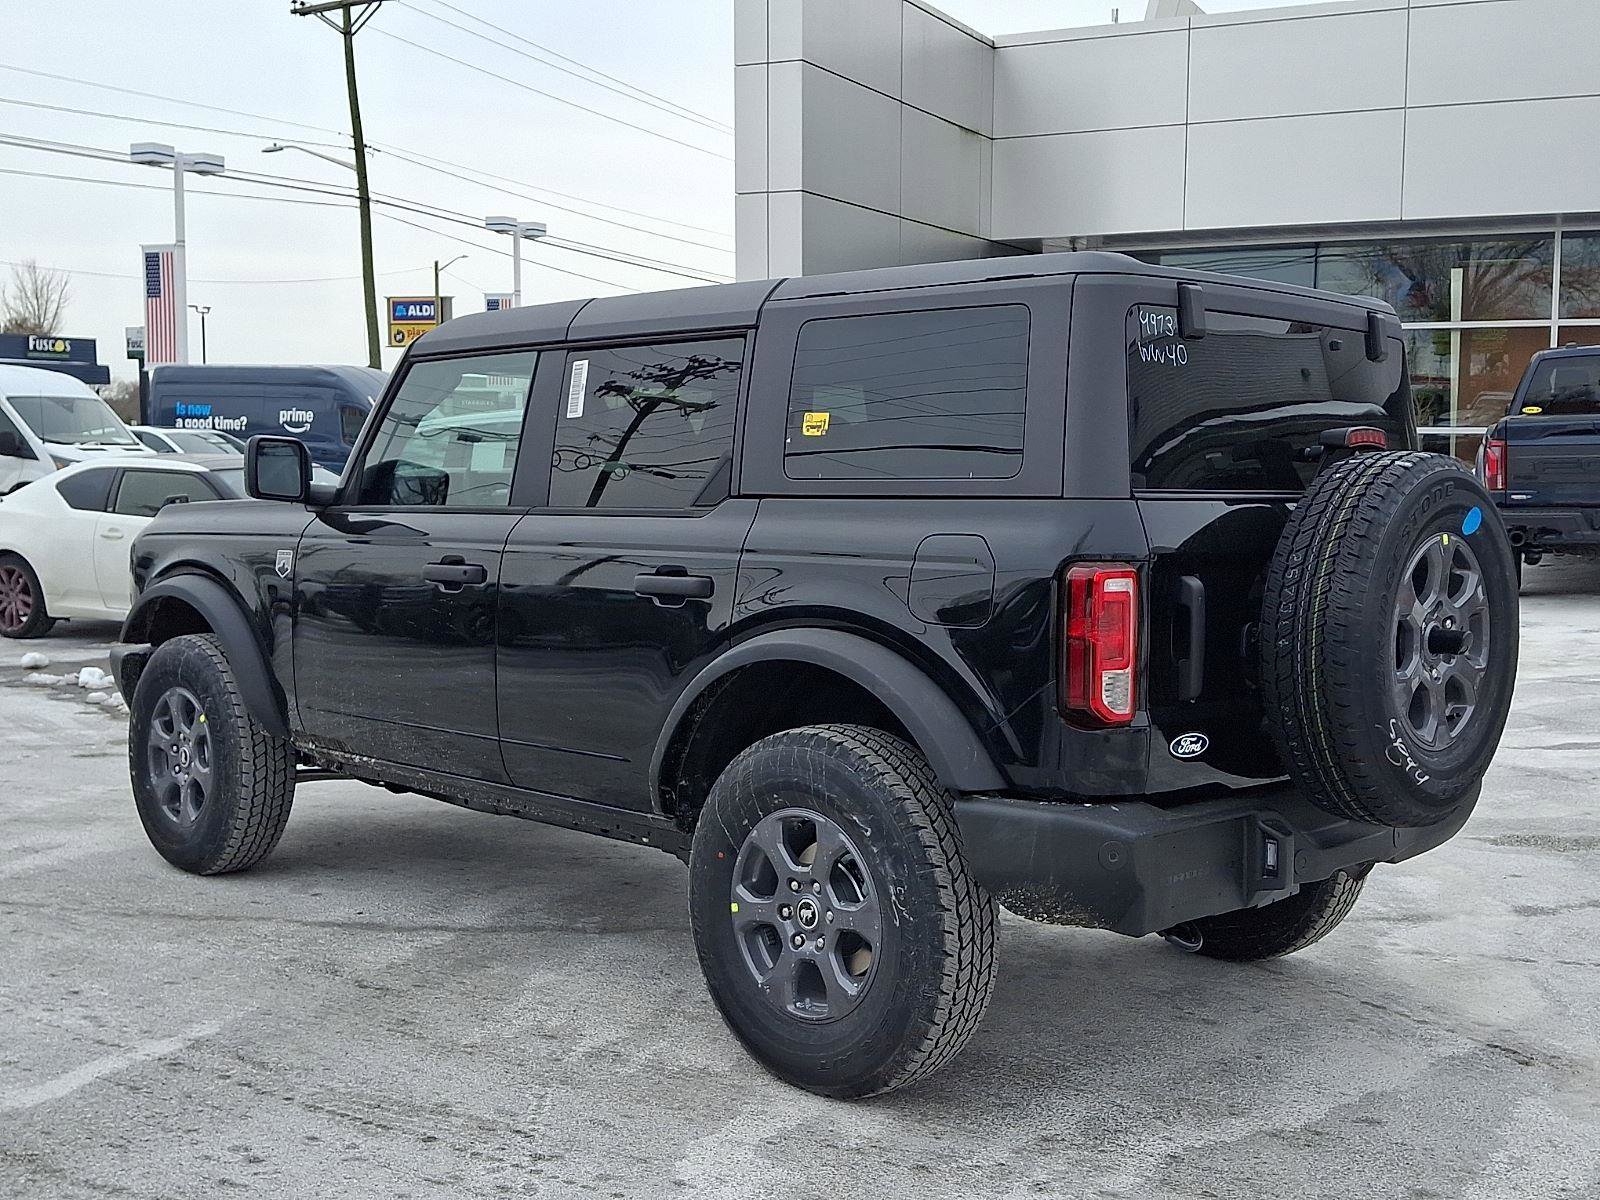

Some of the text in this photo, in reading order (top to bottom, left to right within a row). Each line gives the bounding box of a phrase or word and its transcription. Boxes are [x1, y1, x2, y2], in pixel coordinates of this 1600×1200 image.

[407, 304, 435, 316] ALDI
[1139, 310, 1174, 336] 4973
[187, 403, 212, 415] now
[279, 407, 314, 425] prime
[175, 416, 248, 431] a good time?
